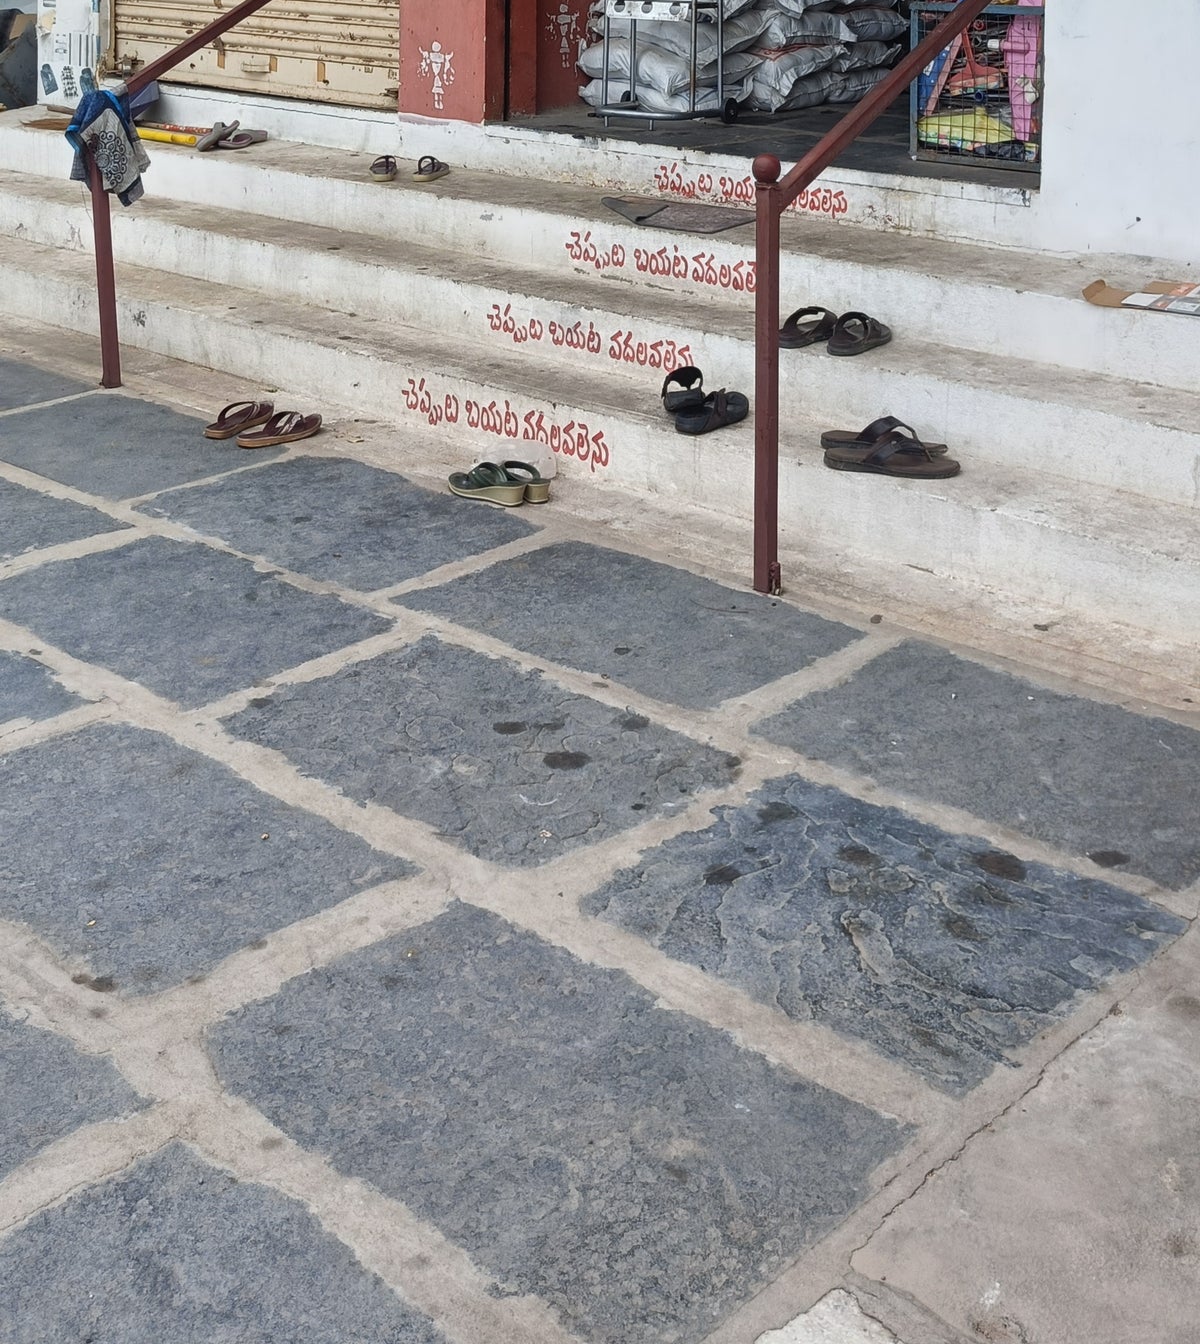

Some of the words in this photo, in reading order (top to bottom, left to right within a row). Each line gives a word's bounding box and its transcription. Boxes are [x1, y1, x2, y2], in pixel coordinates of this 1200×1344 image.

[633, 244, 689, 279] బయట
[548, 320, 601, 354] బయట
[465, 399, 519, 438] బయట
